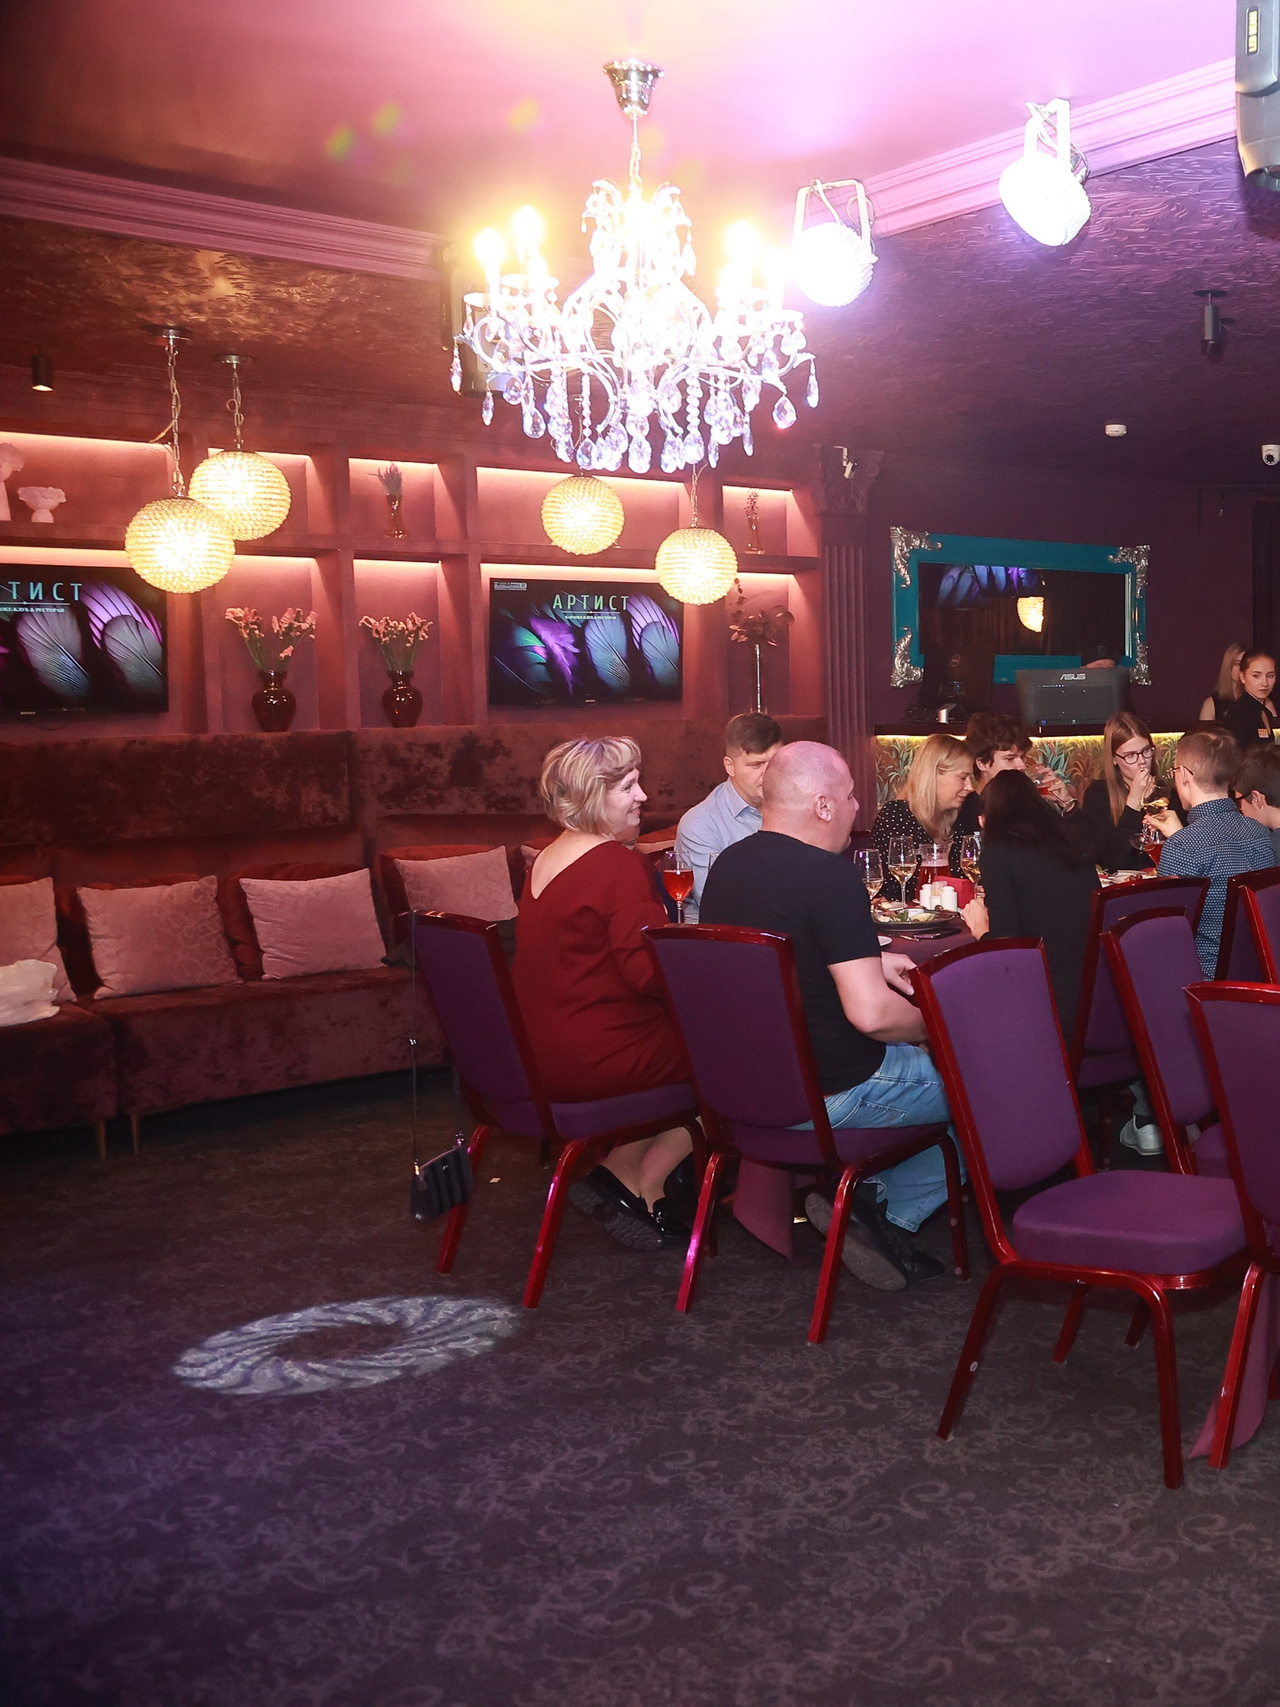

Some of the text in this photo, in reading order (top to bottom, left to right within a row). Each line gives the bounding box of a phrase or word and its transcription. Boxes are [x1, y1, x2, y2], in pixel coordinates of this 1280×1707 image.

[7, 581, 83, 601] ТИСТ
[552, 594, 630, 611] АРТИСТ
[1060, 673, 1087, 681] ASUS
